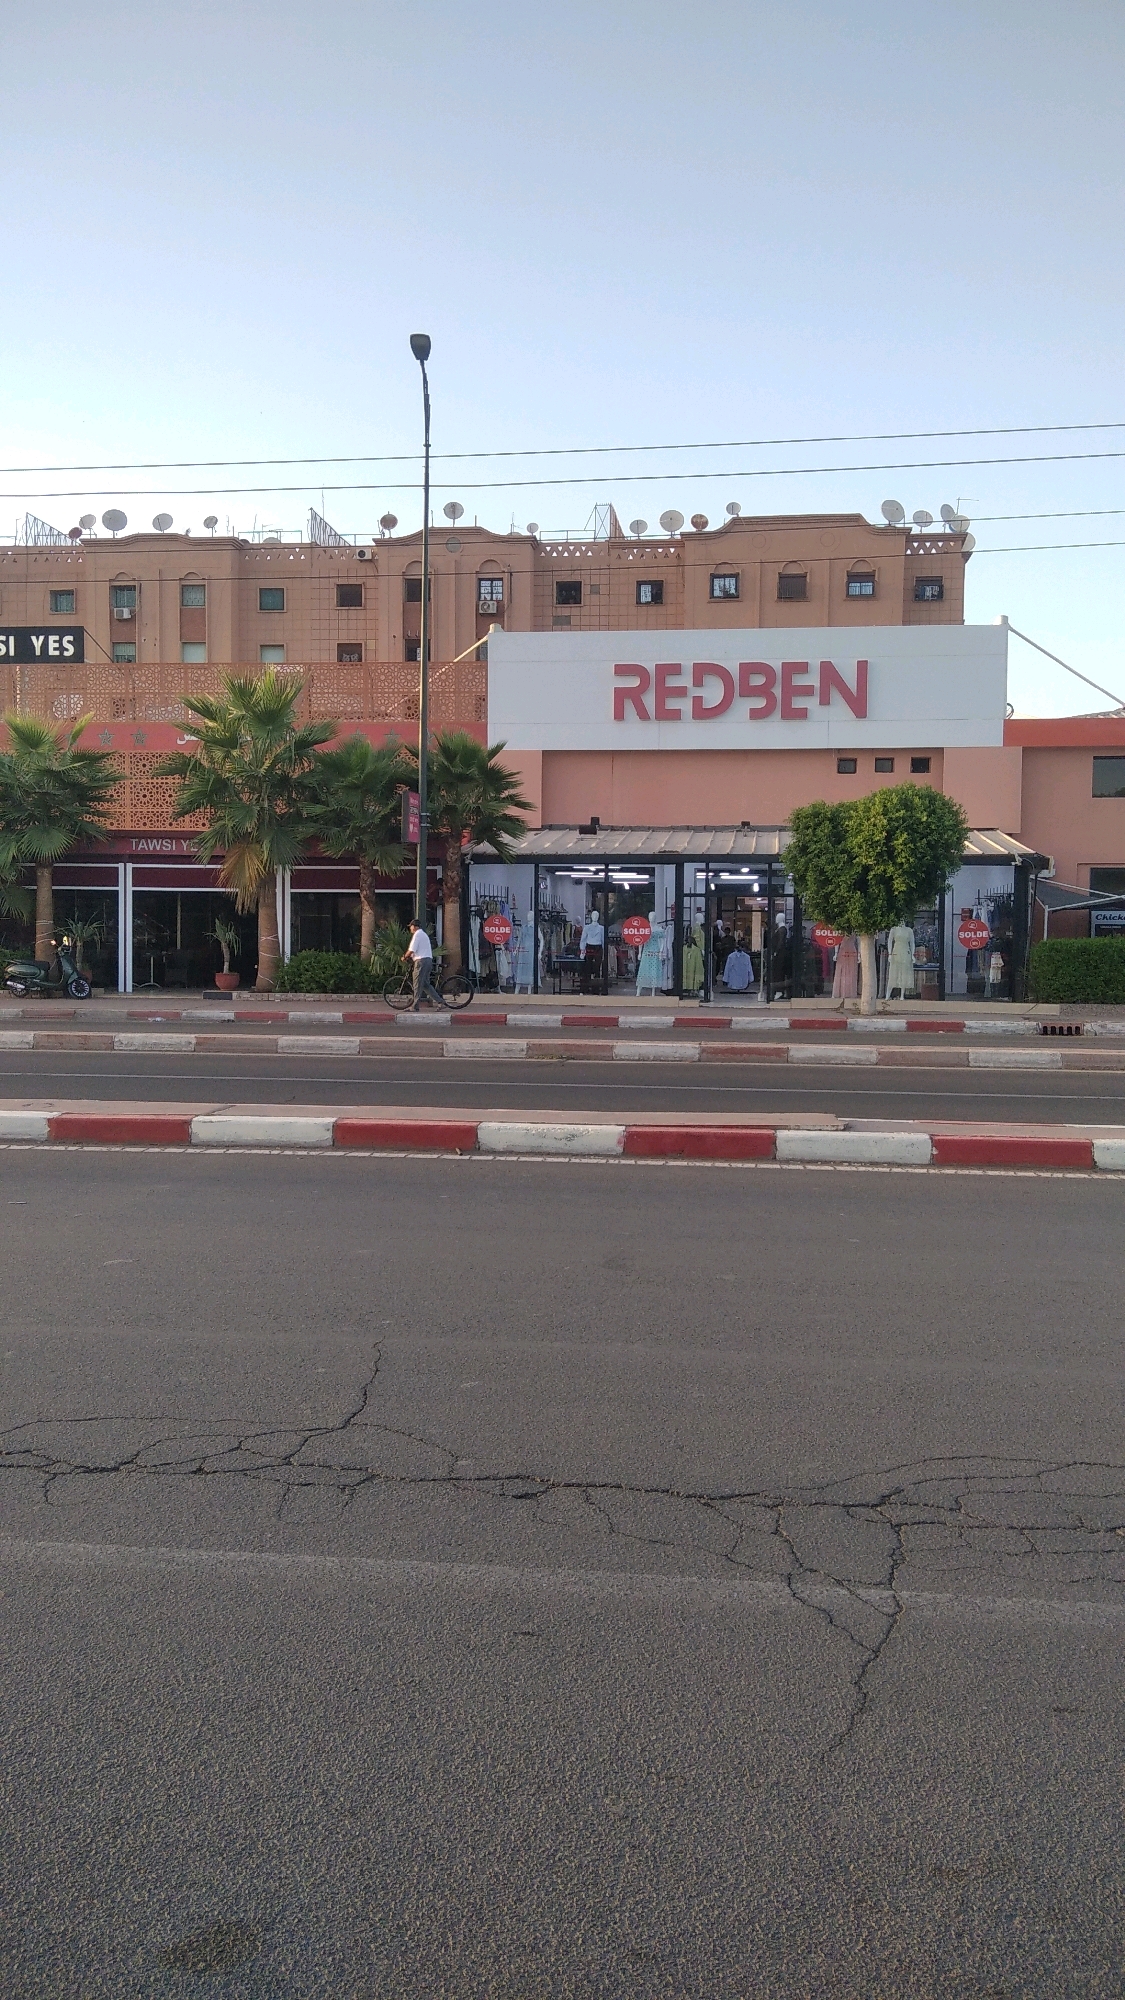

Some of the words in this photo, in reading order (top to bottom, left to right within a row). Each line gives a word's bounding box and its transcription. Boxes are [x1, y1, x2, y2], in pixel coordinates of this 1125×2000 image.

[30, 635, 75, 656] YES
[613, 660, 869, 720] REDBEN
[130, 839, 176, 851] TAWSI
[181, 840, 206, 852] YE
[623, 927, 650, 935] SOLDE
[958, 930, 989, 938] SOLDE
